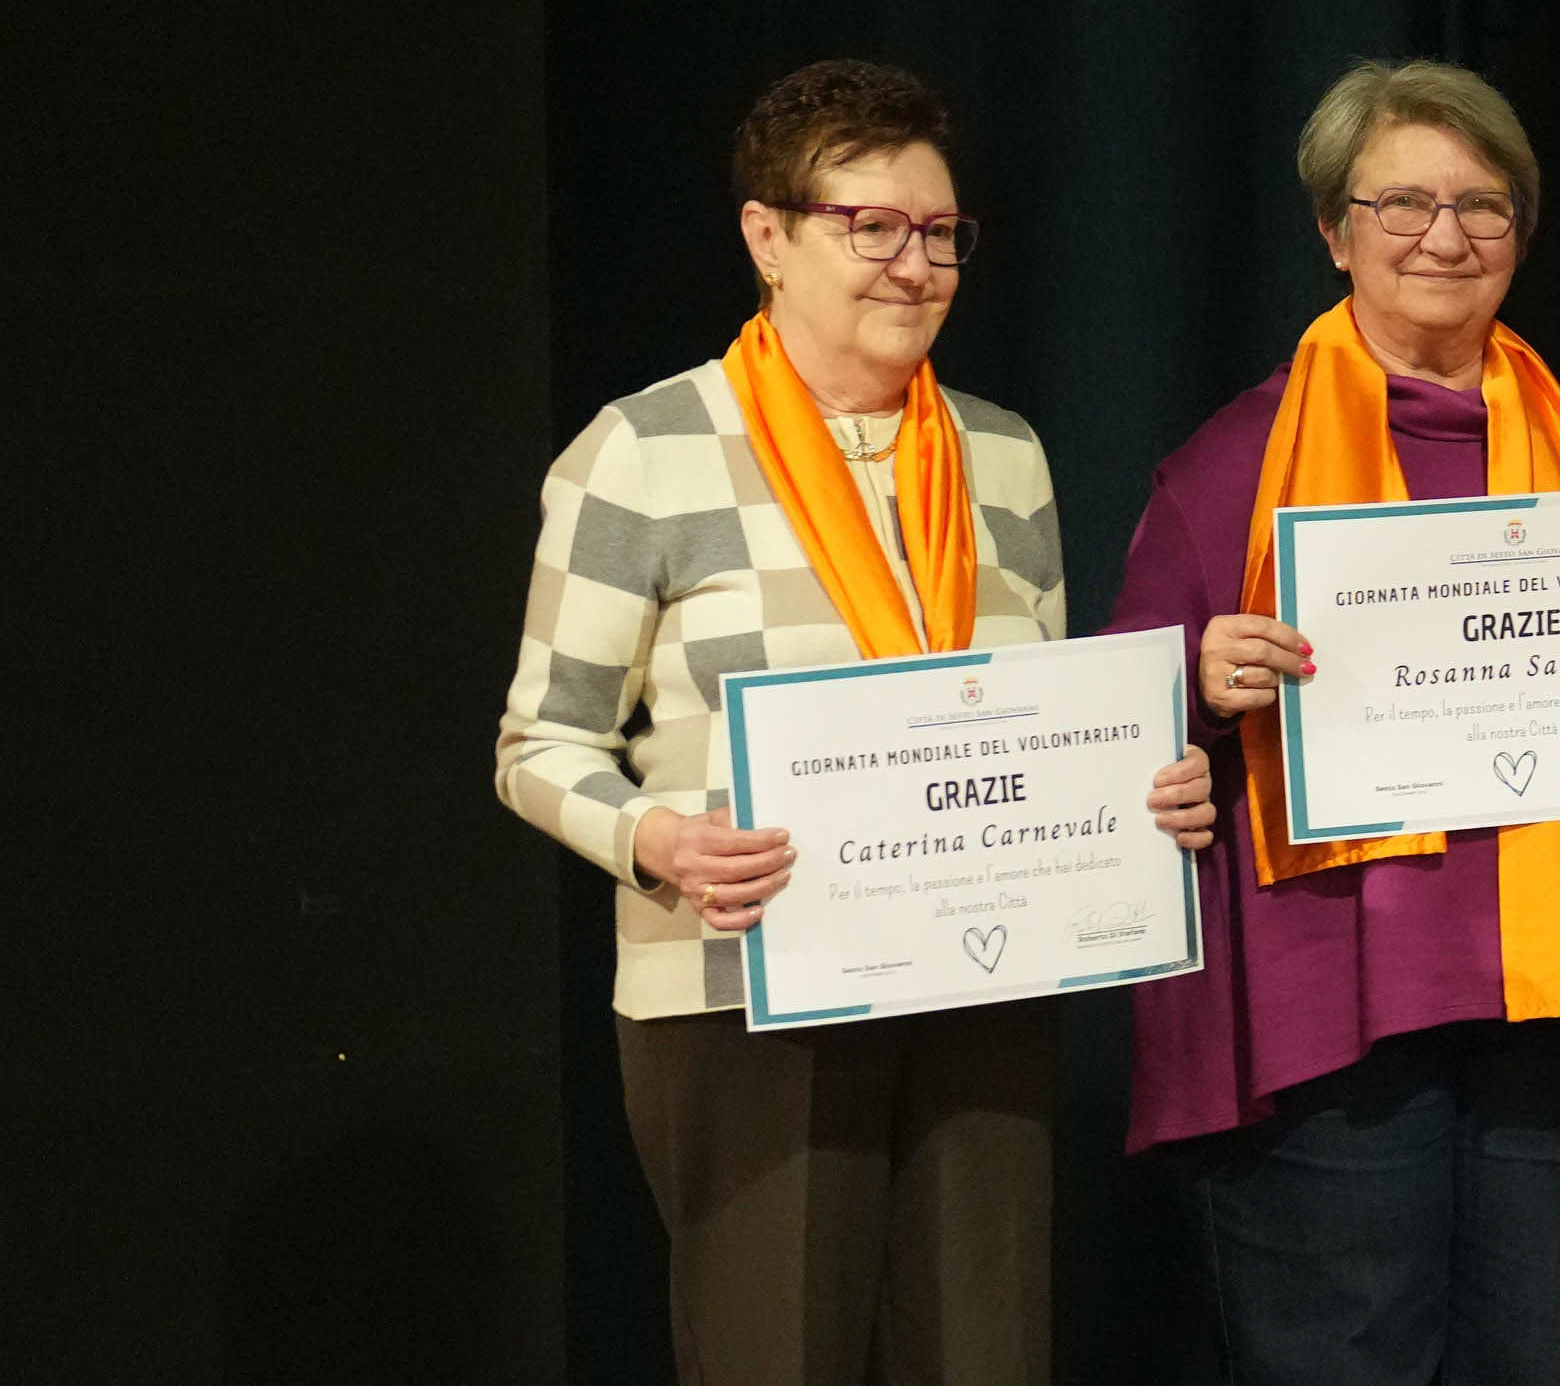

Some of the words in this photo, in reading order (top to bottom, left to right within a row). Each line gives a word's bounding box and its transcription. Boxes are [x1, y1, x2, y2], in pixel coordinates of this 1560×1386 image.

[1336, 586, 1420, 605] GIORNATA
[1428, 579, 1511, 598] MONDIALE
[1520, 577, 1548, 592] DEL
[1395, 663, 1512, 686] Rosanna
[1366, 706, 1385, 722] Per
[1389, 702, 1395, 721] il
[1399, 709, 1438, 722] tempo,
[1442, 698, 1453, 716] la
[1456, 702, 1505, 719] passione
[1519, 692, 1560, 709] l'amore
[1466, 723, 1487, 741] alla
[1490, 727, 1527, 739] nostra
[1530, 719, 1559, 736] Città
[792, 753, 879, 776] GIORNATA
[888, 743, 972, 765] MONDIALE
[981, 740, 1010, 756] DEL
[1018, 723, 1140, 751] VOLONTARIATO
[926, 773, 1027, 811] GRAZIE
[840, 833, 965, 864] Caterina
[982, 805, 1117, 847] Carnevale
